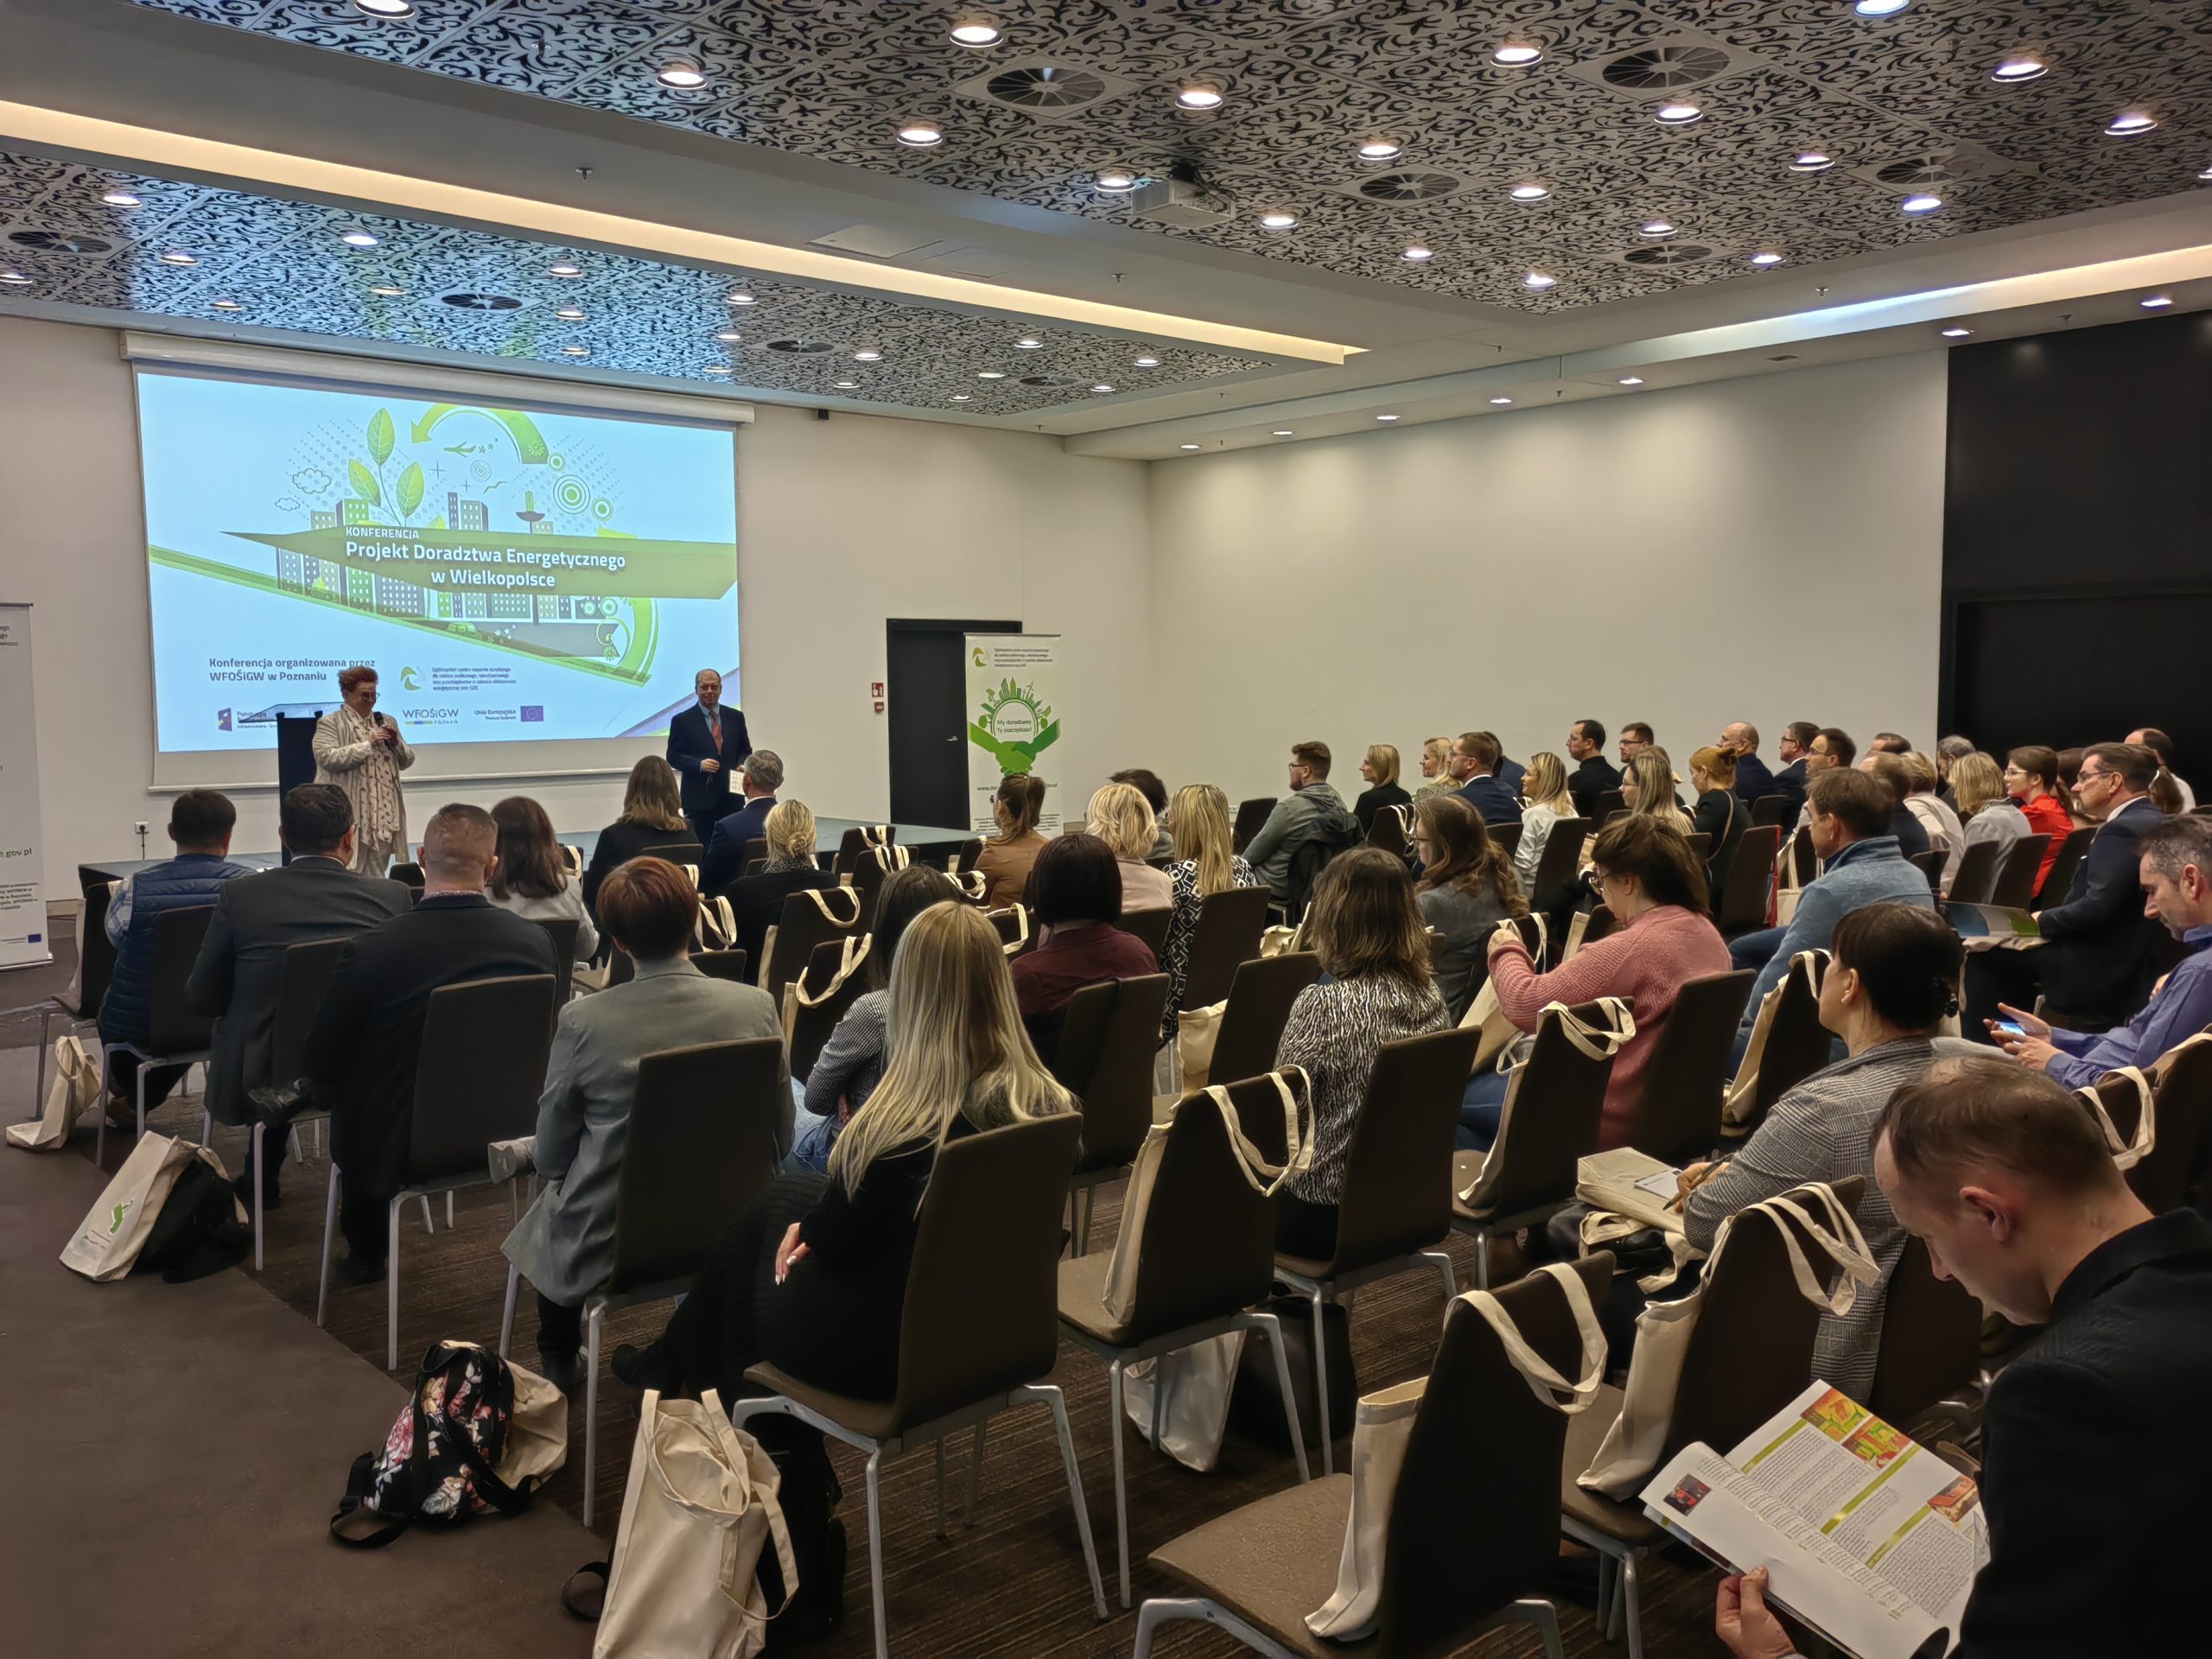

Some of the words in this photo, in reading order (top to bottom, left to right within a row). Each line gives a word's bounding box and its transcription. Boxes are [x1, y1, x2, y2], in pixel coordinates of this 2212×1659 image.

[346, 526, 420, 540] KONFERENCJA
[346, 541, 409, 562] Projekt
[414, 543, 502, 563] Doradztwa
[506, 548, 626, 571] Energetycznego
[431, 572, 446, 584] w
[449, 569, 556, 589] Wielkopolsce
[209, 658, 273, 670] Konferencja
[275, 658, 346, 670] organizowana
[349, 659, 376, 668] przez
[210, 670, 264, 681] WFOŚiGW
[279, 671, 327, 681] Poznaniu
